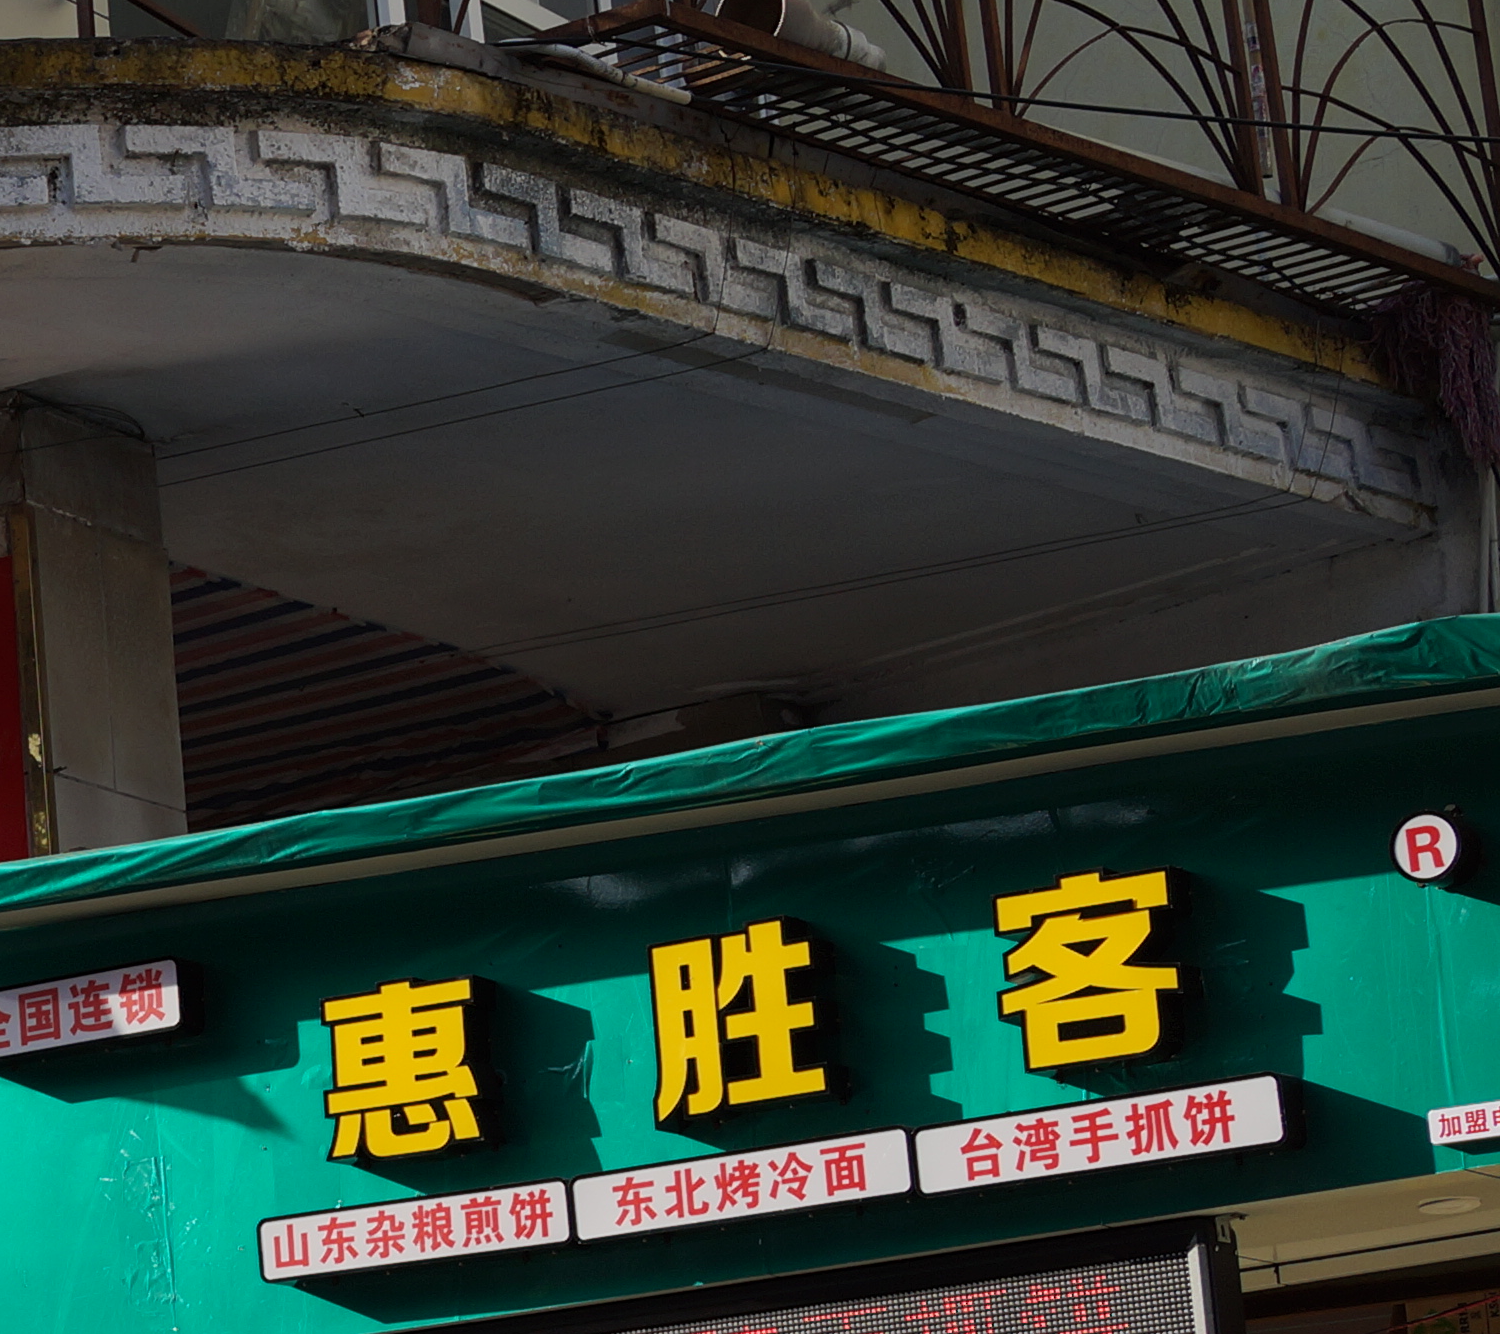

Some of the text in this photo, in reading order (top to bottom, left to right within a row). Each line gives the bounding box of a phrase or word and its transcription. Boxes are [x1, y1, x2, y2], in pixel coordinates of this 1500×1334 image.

[321, 867, 1182, 1160] 惠胜客
[271, 1090, 1236, 1275] 山东杂粮煎饼 东北烤冷面 台湾手抓饼
